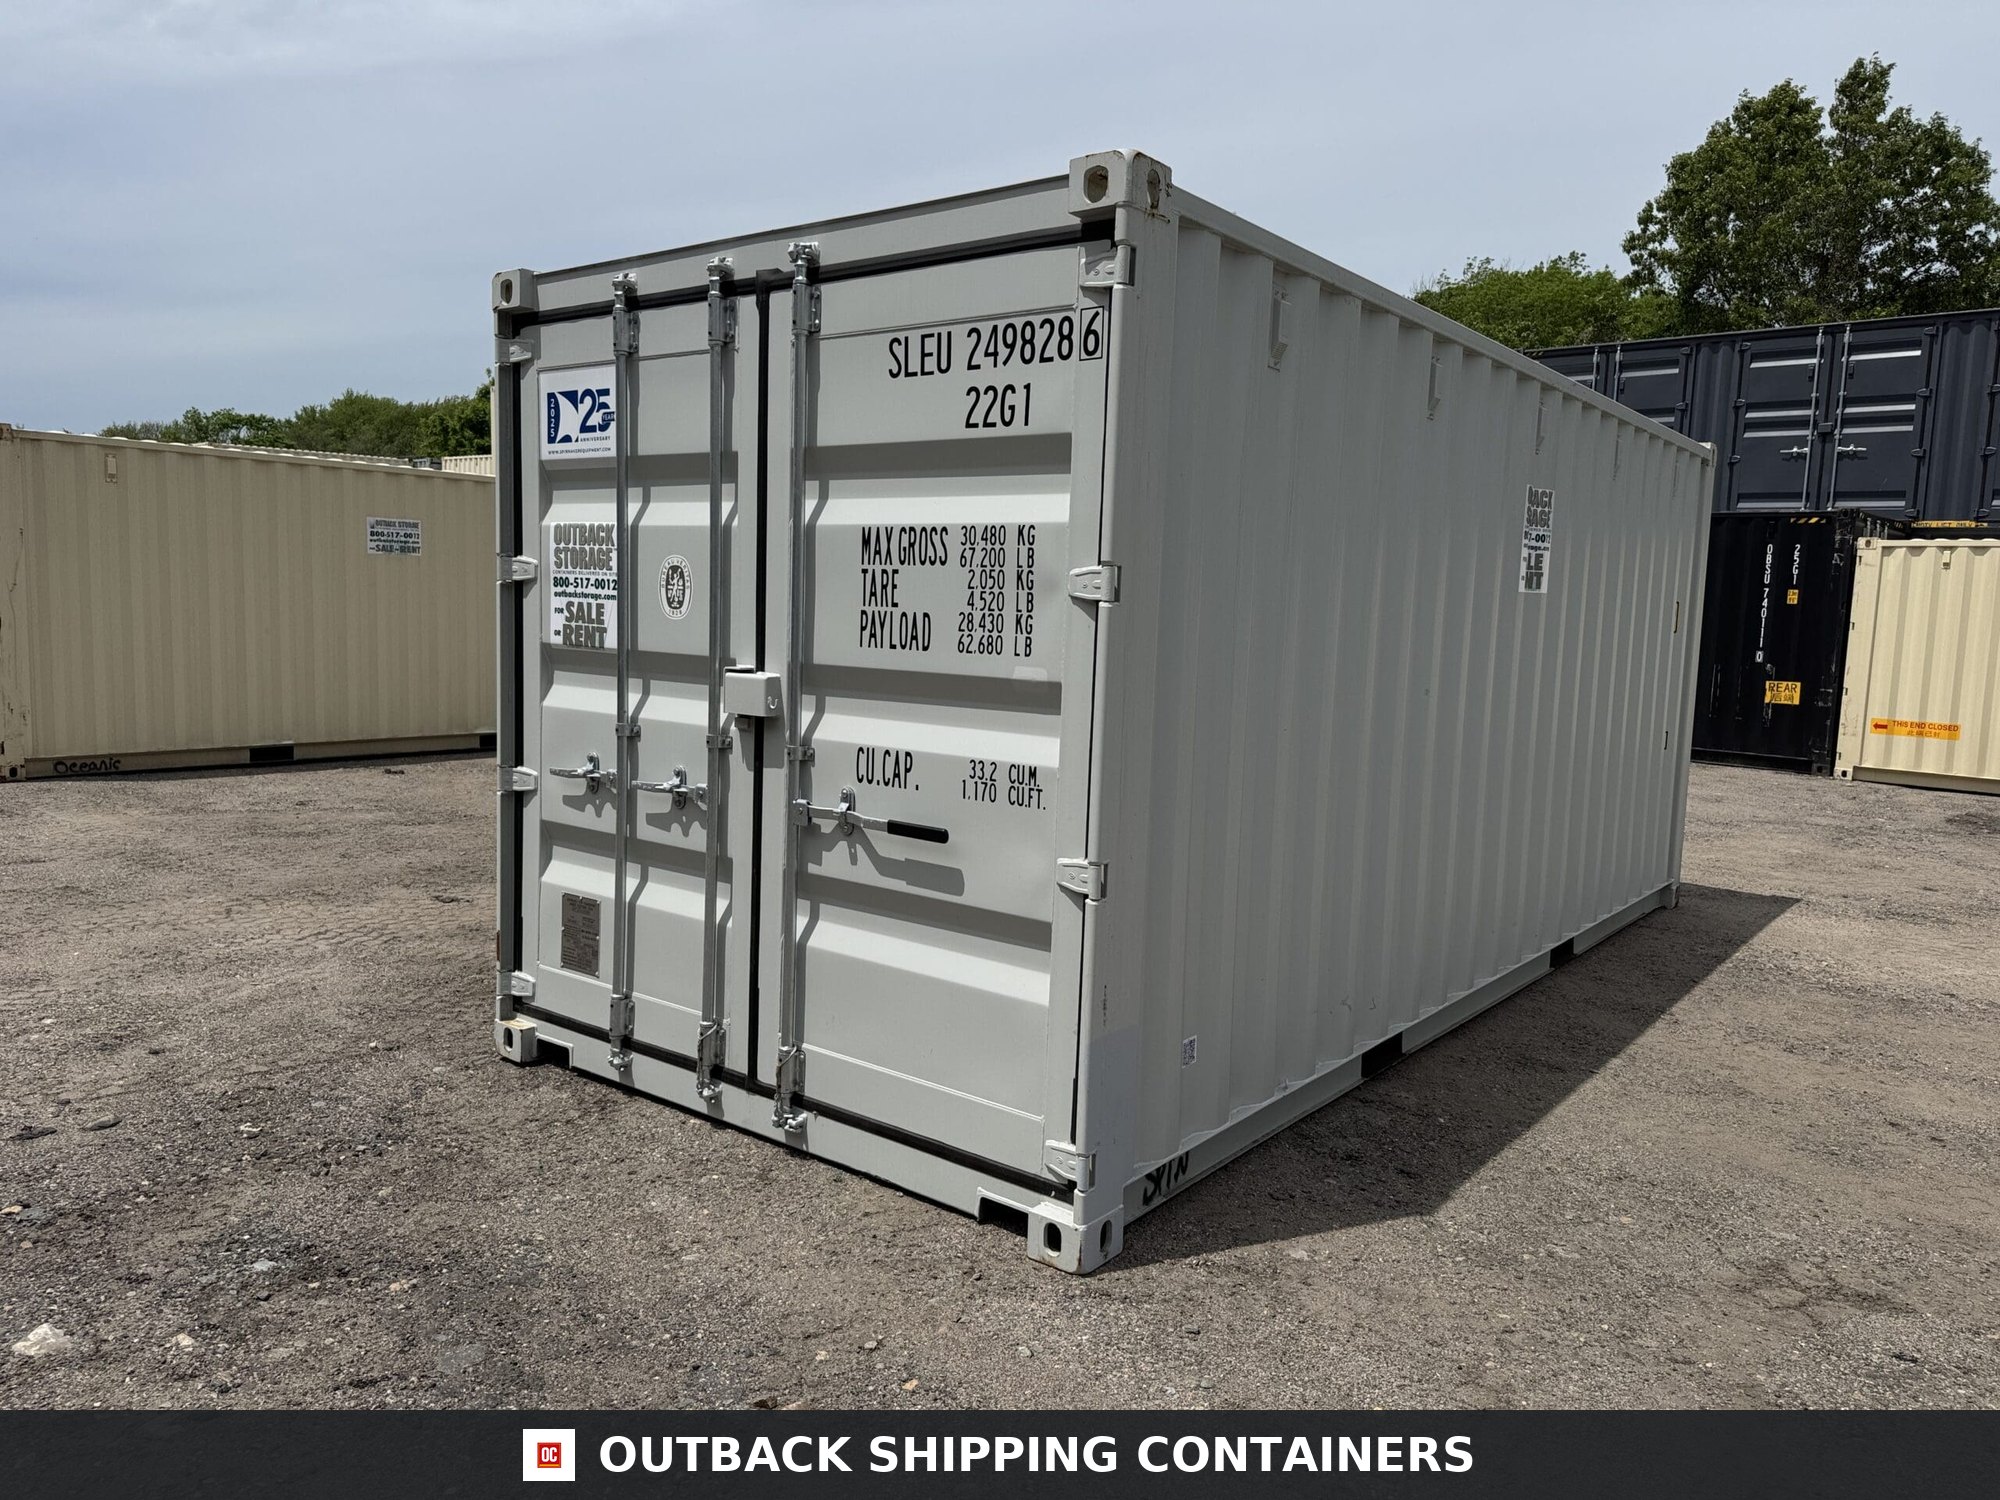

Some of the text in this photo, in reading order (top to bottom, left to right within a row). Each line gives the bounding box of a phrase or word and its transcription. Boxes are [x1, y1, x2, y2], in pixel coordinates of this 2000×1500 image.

[888, 331, 952, 379] SLEU
[965, 382, 1031, 429] 22G1
[553, 522, 616, 547] OUTBACK
[861, 525, 1036, 566] MAX GROSS 30,480 KG
[553, 546, 613, 571] STORAGE
[959, 547, 1035, 568] 67,200 LB
[553, 576, 618, 591] 800-517-0012
[553, 589, 617, 601] outbackstorage.com
[861, 568, 1034, 608] TARE 2,050 KG
[565, 600, 605, 626] SALE
[966, 590, 1034, 613] 4,520 LB
[562, 623, 608, 649] RENT
[859, 610, 1033, 652] PAYLOAD 28,430 KG
[957, 633, 1032, 657] 62,680 LB
[1768, 682, 1798, 694] REAR
[1892, 720, 1909, 728] THIS
[1928, 723, 1959, 732] CLOSED
[54, 756, 121, 774] Oceanic
[856, 746, 920, 791] CU.CAP.
[968, 759, 997, 782] 33.2
[962, 779, 997, 803] 1,170
